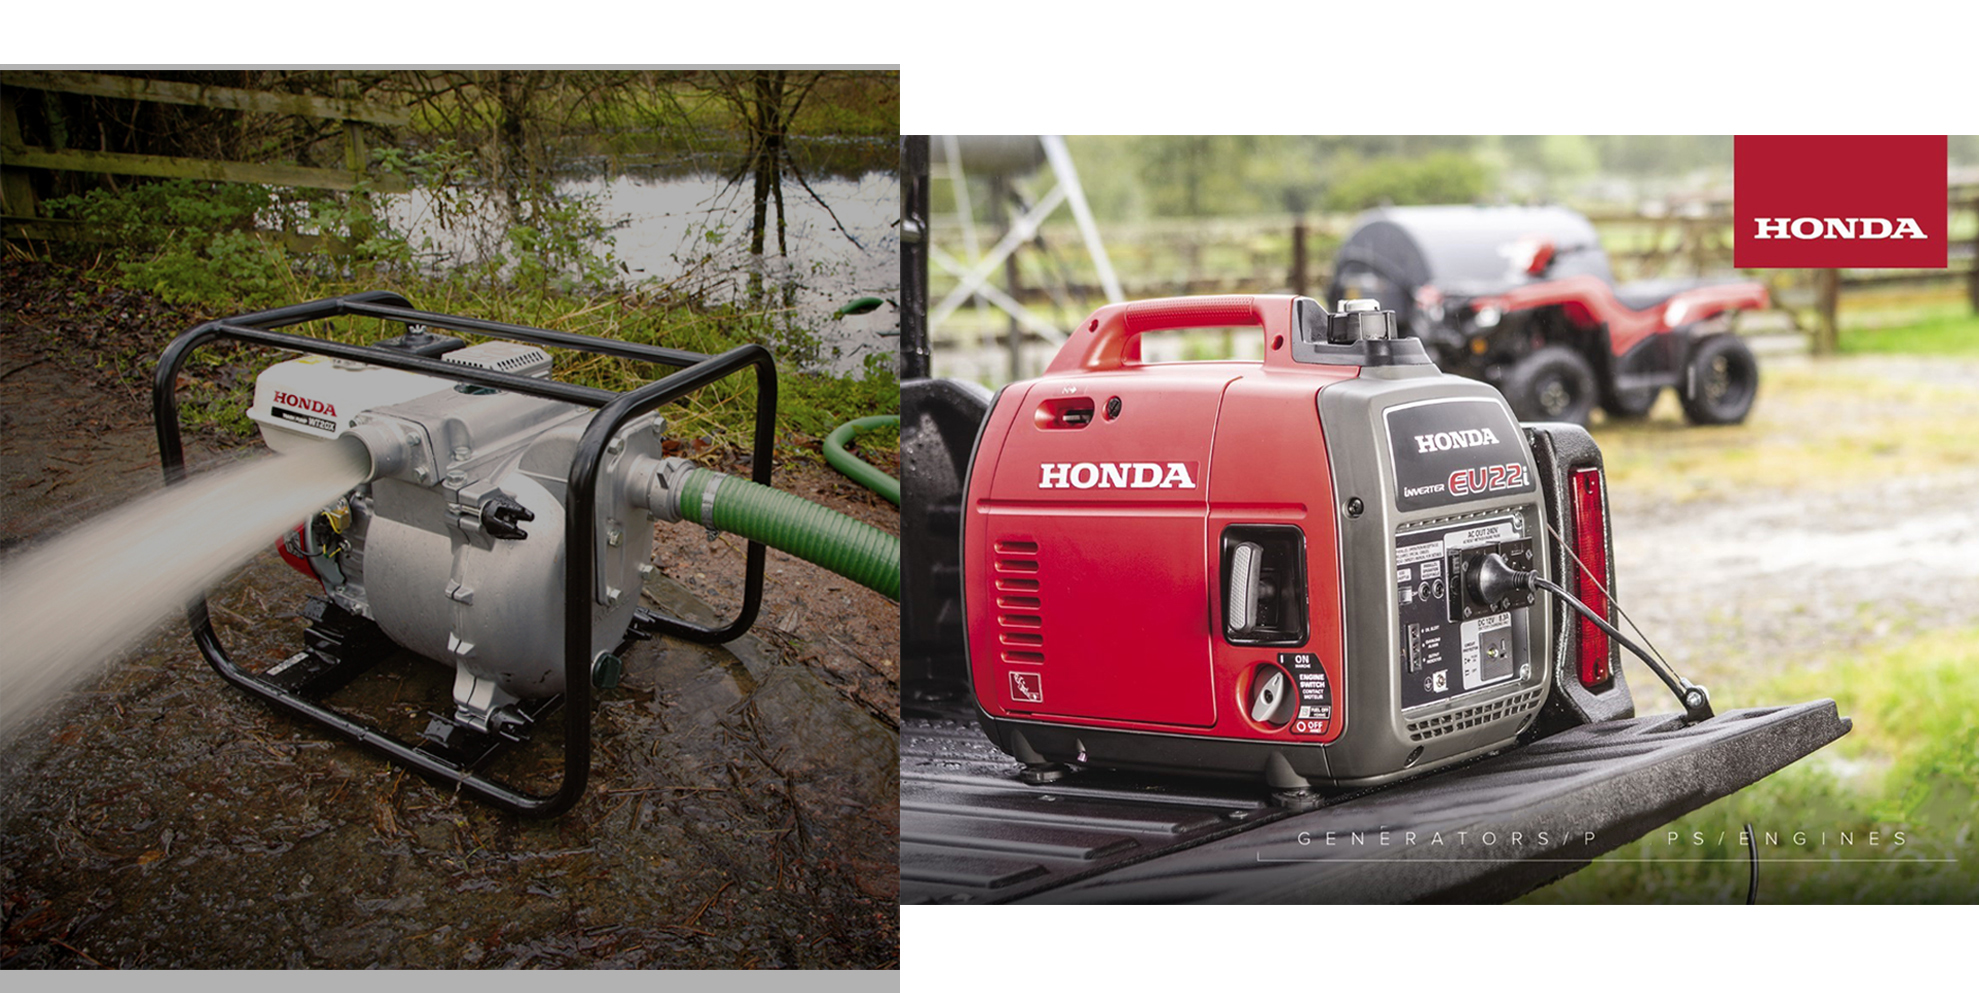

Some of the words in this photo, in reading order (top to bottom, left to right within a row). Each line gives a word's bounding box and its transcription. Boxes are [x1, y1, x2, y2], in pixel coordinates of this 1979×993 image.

[273, 391, 337, 417] HONDA
[1414, 428, 1499, 453] HONDA
[1038, 462, 1196, 489] HONDA
[1448, 462, 1530, 496] EU22i
[1295, 655, 1310, 664] ON
[1307, 721, 1323, 729] OFF
